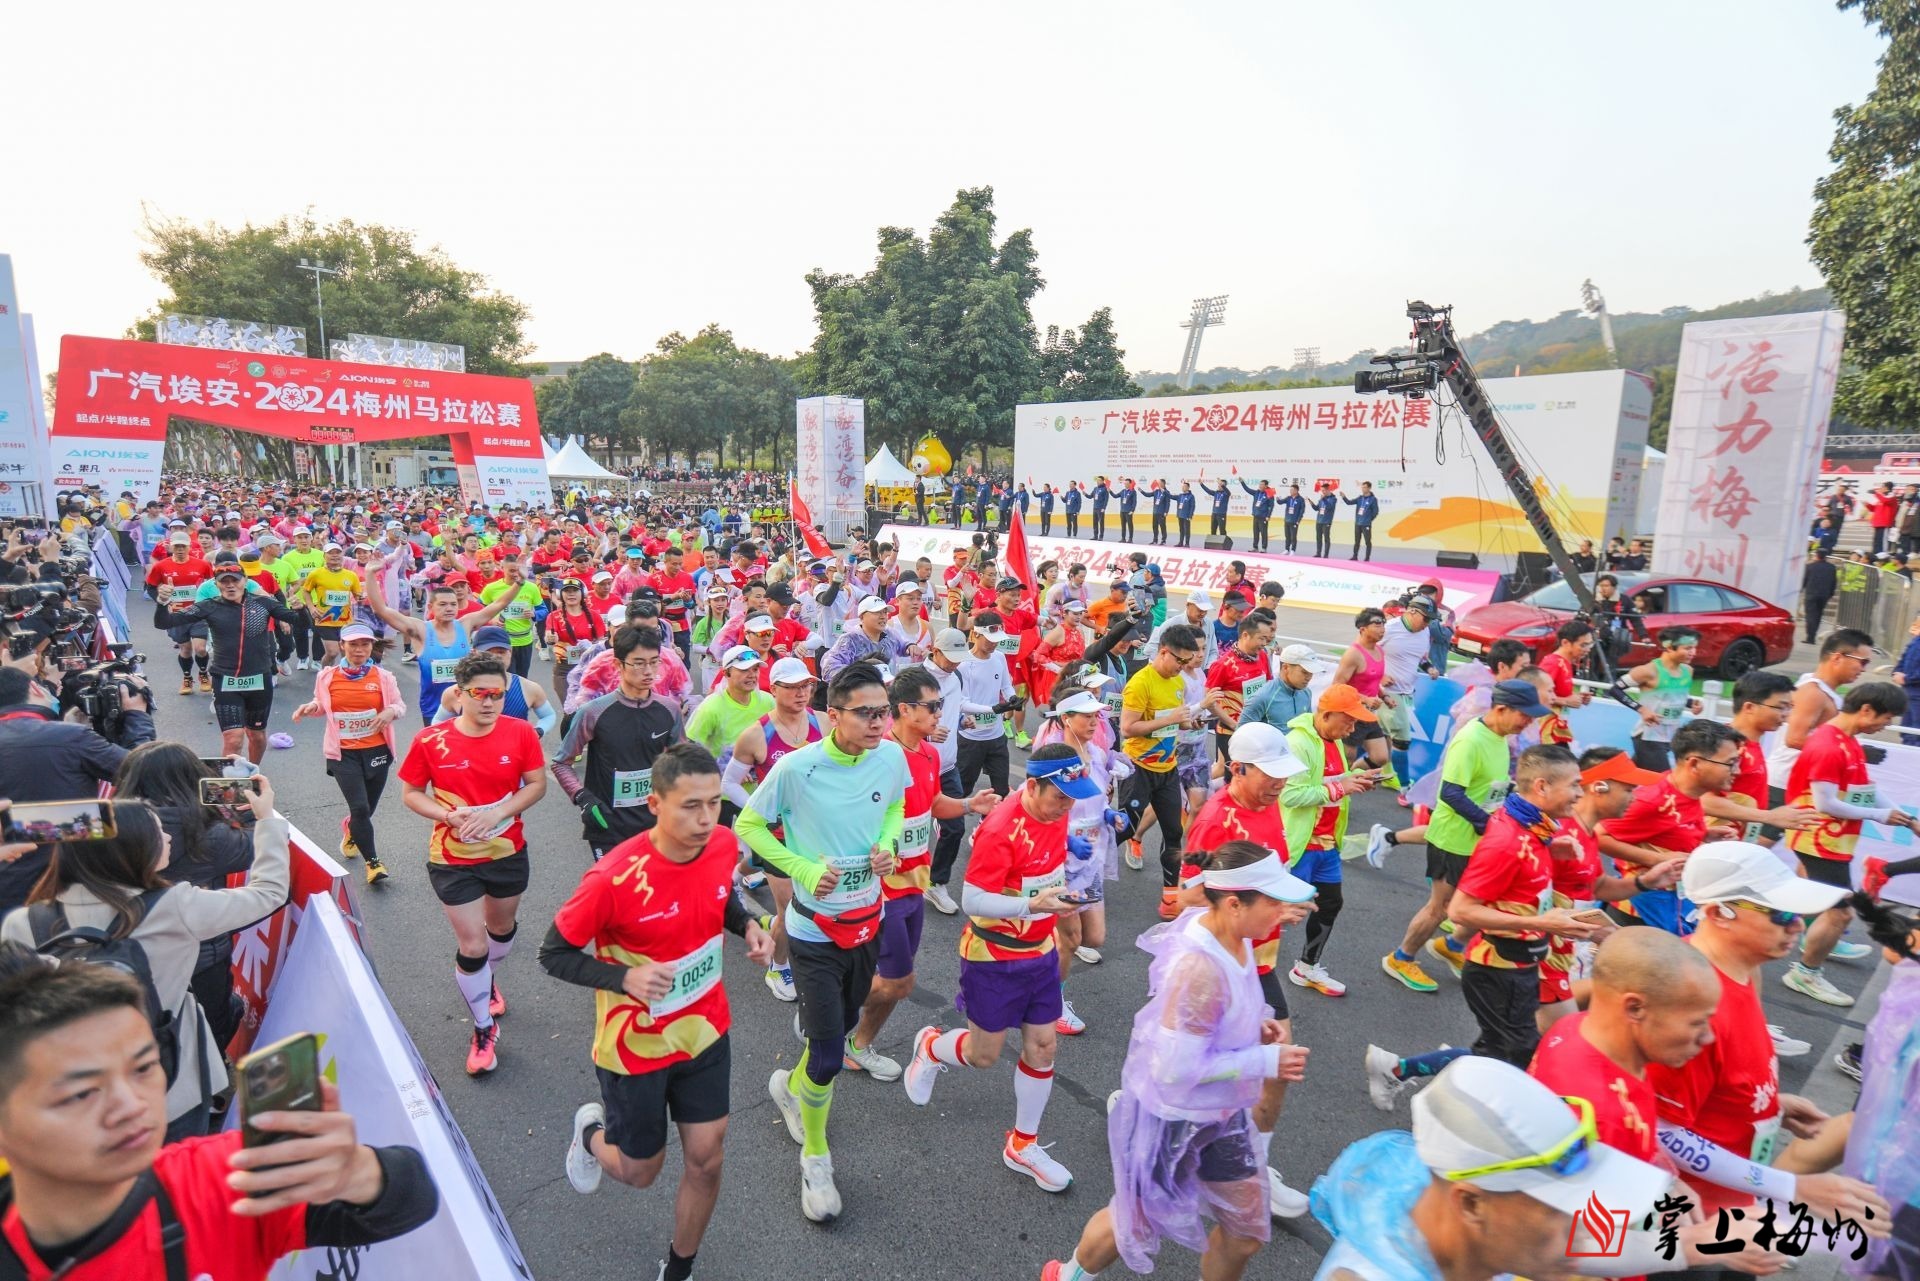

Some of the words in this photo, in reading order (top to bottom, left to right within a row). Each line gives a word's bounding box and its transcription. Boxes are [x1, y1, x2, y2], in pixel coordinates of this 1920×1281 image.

[76, 413, 151, 427] 起点/半程终点
[1684, 341, 1784, 588] 活力梅州
[436, 666, 443, 675] B
[226, 677, 235, 686] B
[237, 676, 254, 686] 0611
[1246, 685, 1252, 695] B
[339, 719, 346, 729] B
[622, 781, 632, 794] B
[904, 830, 914, 843] B
[682, 955, 714, 988] 0032
